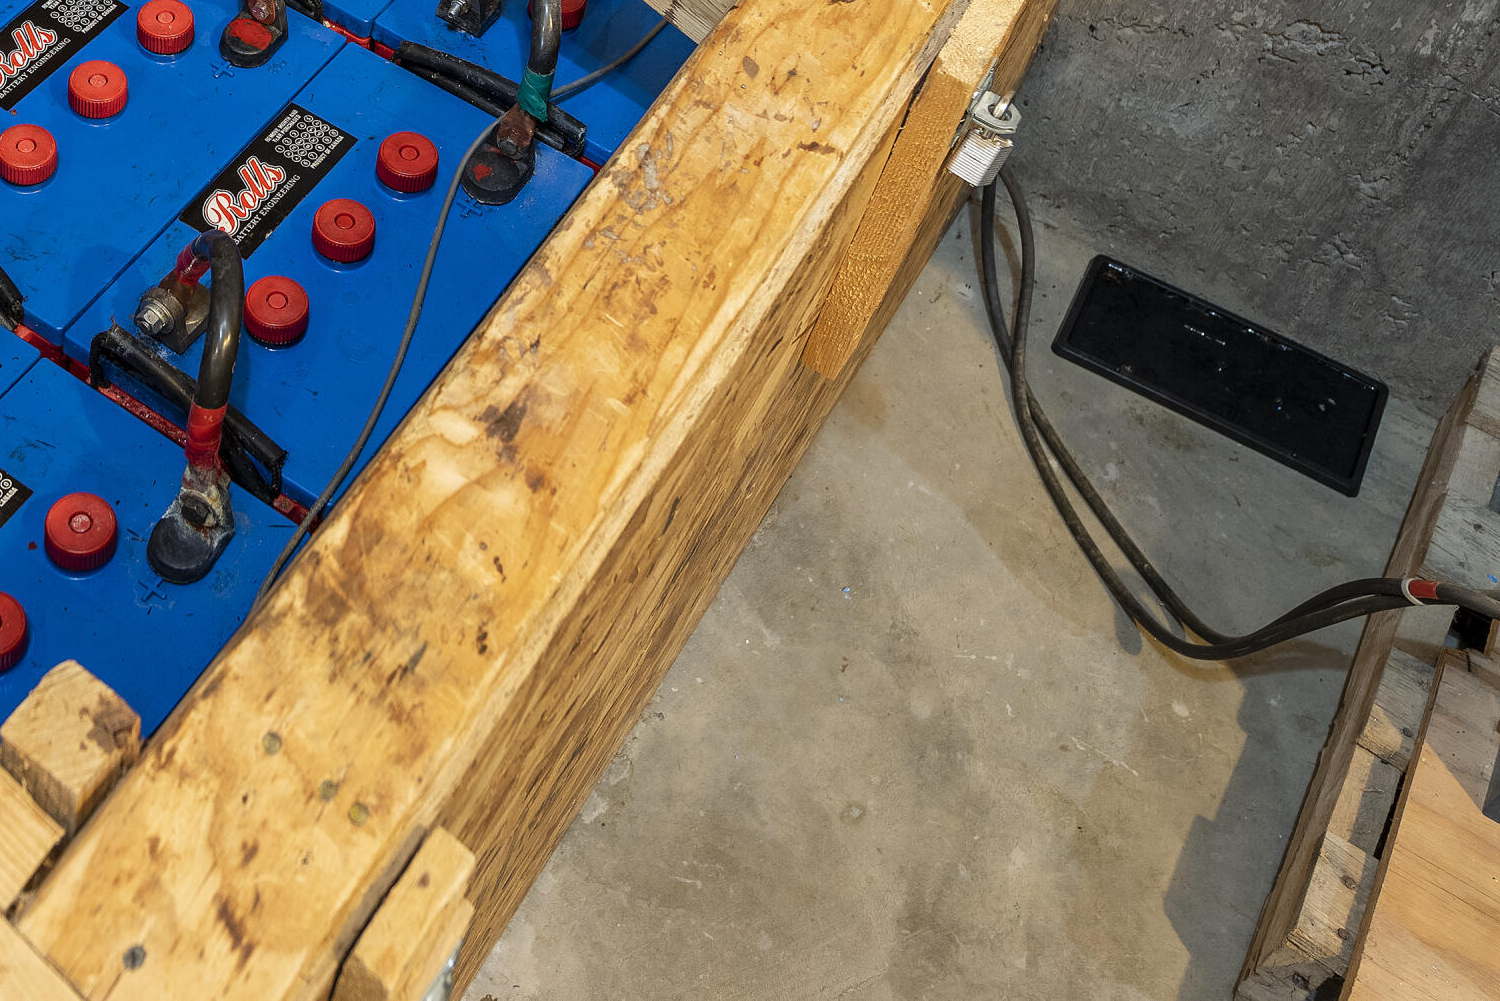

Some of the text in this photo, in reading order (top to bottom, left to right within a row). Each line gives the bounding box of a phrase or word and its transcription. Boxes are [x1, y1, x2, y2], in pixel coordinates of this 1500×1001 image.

[27, 38, 70, 73] ENGINEERING
[203, 156, 286, 237] Rolls
[259, 175, 300, 215] ENGINEERING
